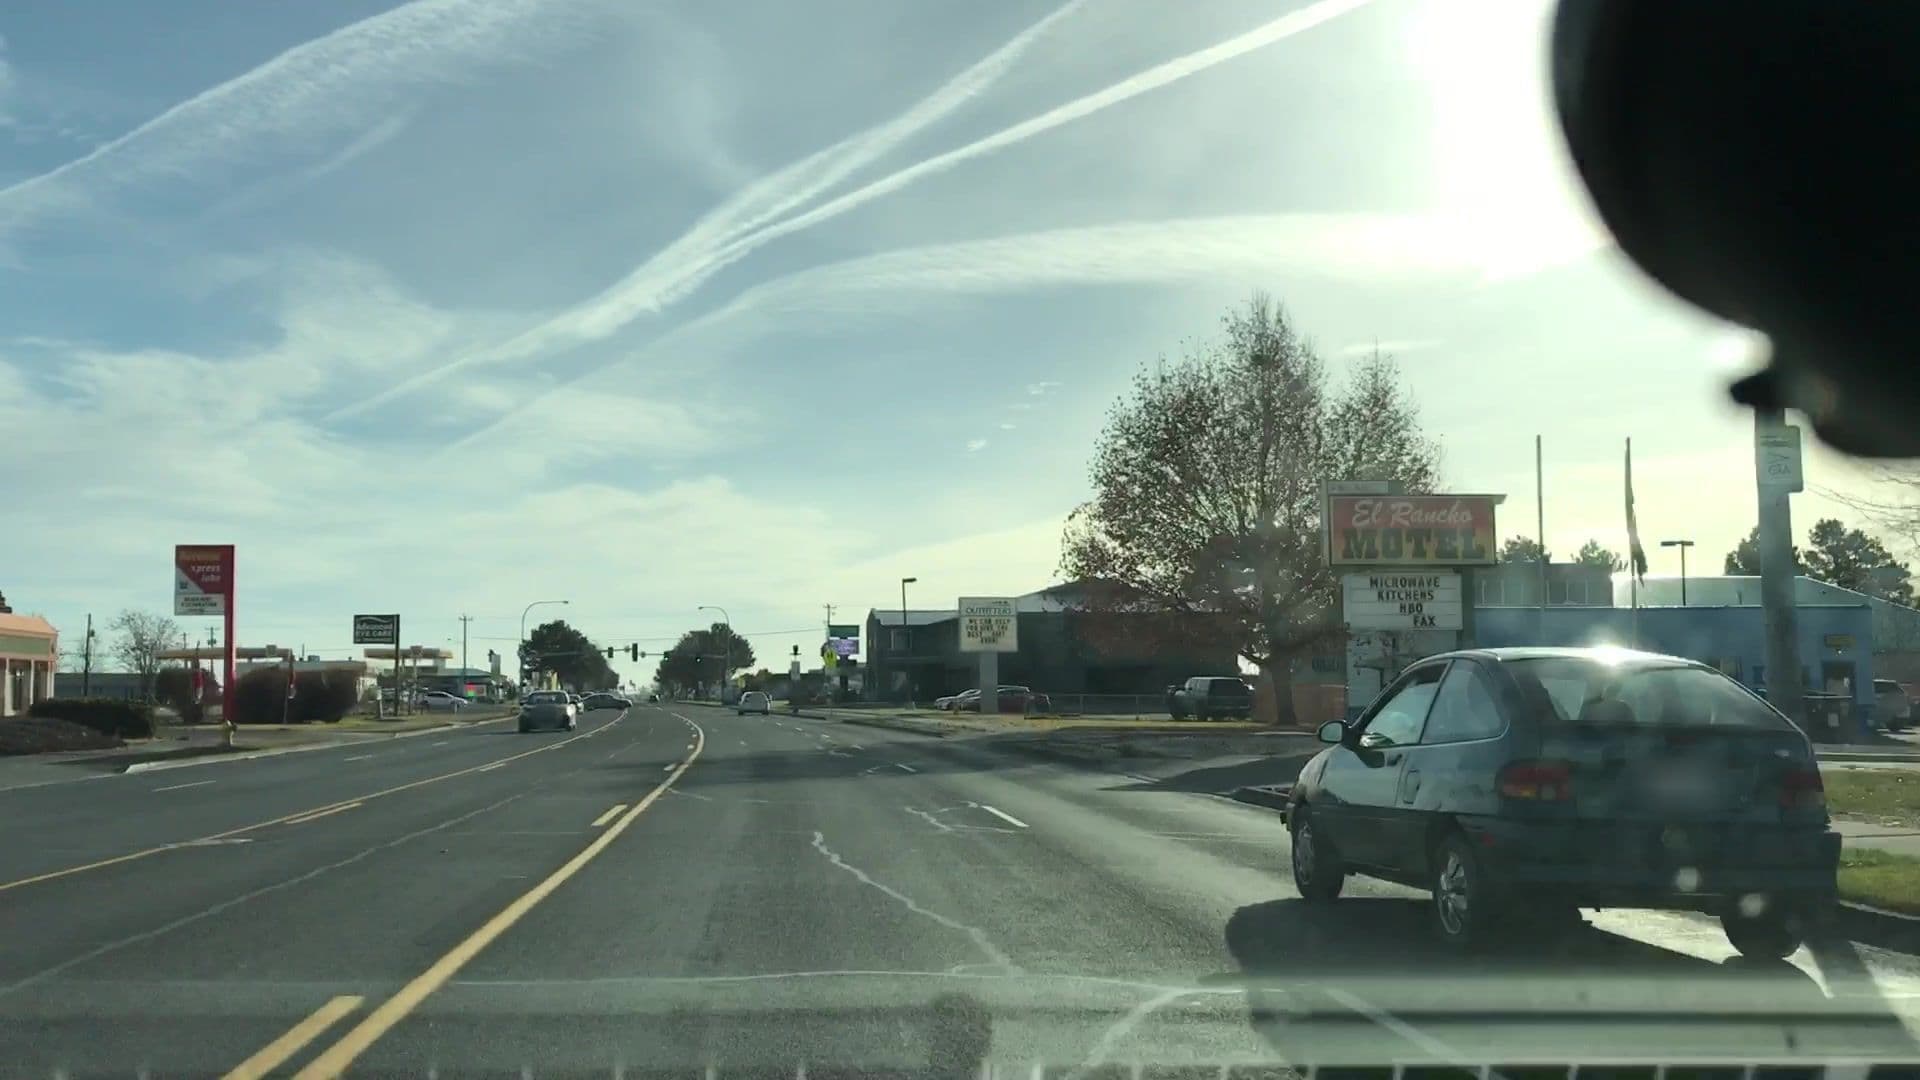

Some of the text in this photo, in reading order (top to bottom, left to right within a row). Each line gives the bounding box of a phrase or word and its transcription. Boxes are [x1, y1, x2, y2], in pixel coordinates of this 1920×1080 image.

[1352, 500, 1473, 527] El Rancho
[1342, 528, 1486, 559] MOTEL
[1369, 576, 1440, 588] MICROWAVE
[1377, 589, 1435, 602] KITCHENS
[1399, 602, 1424, 615] HBO
[1413, 615, 1437, 627] FAX
